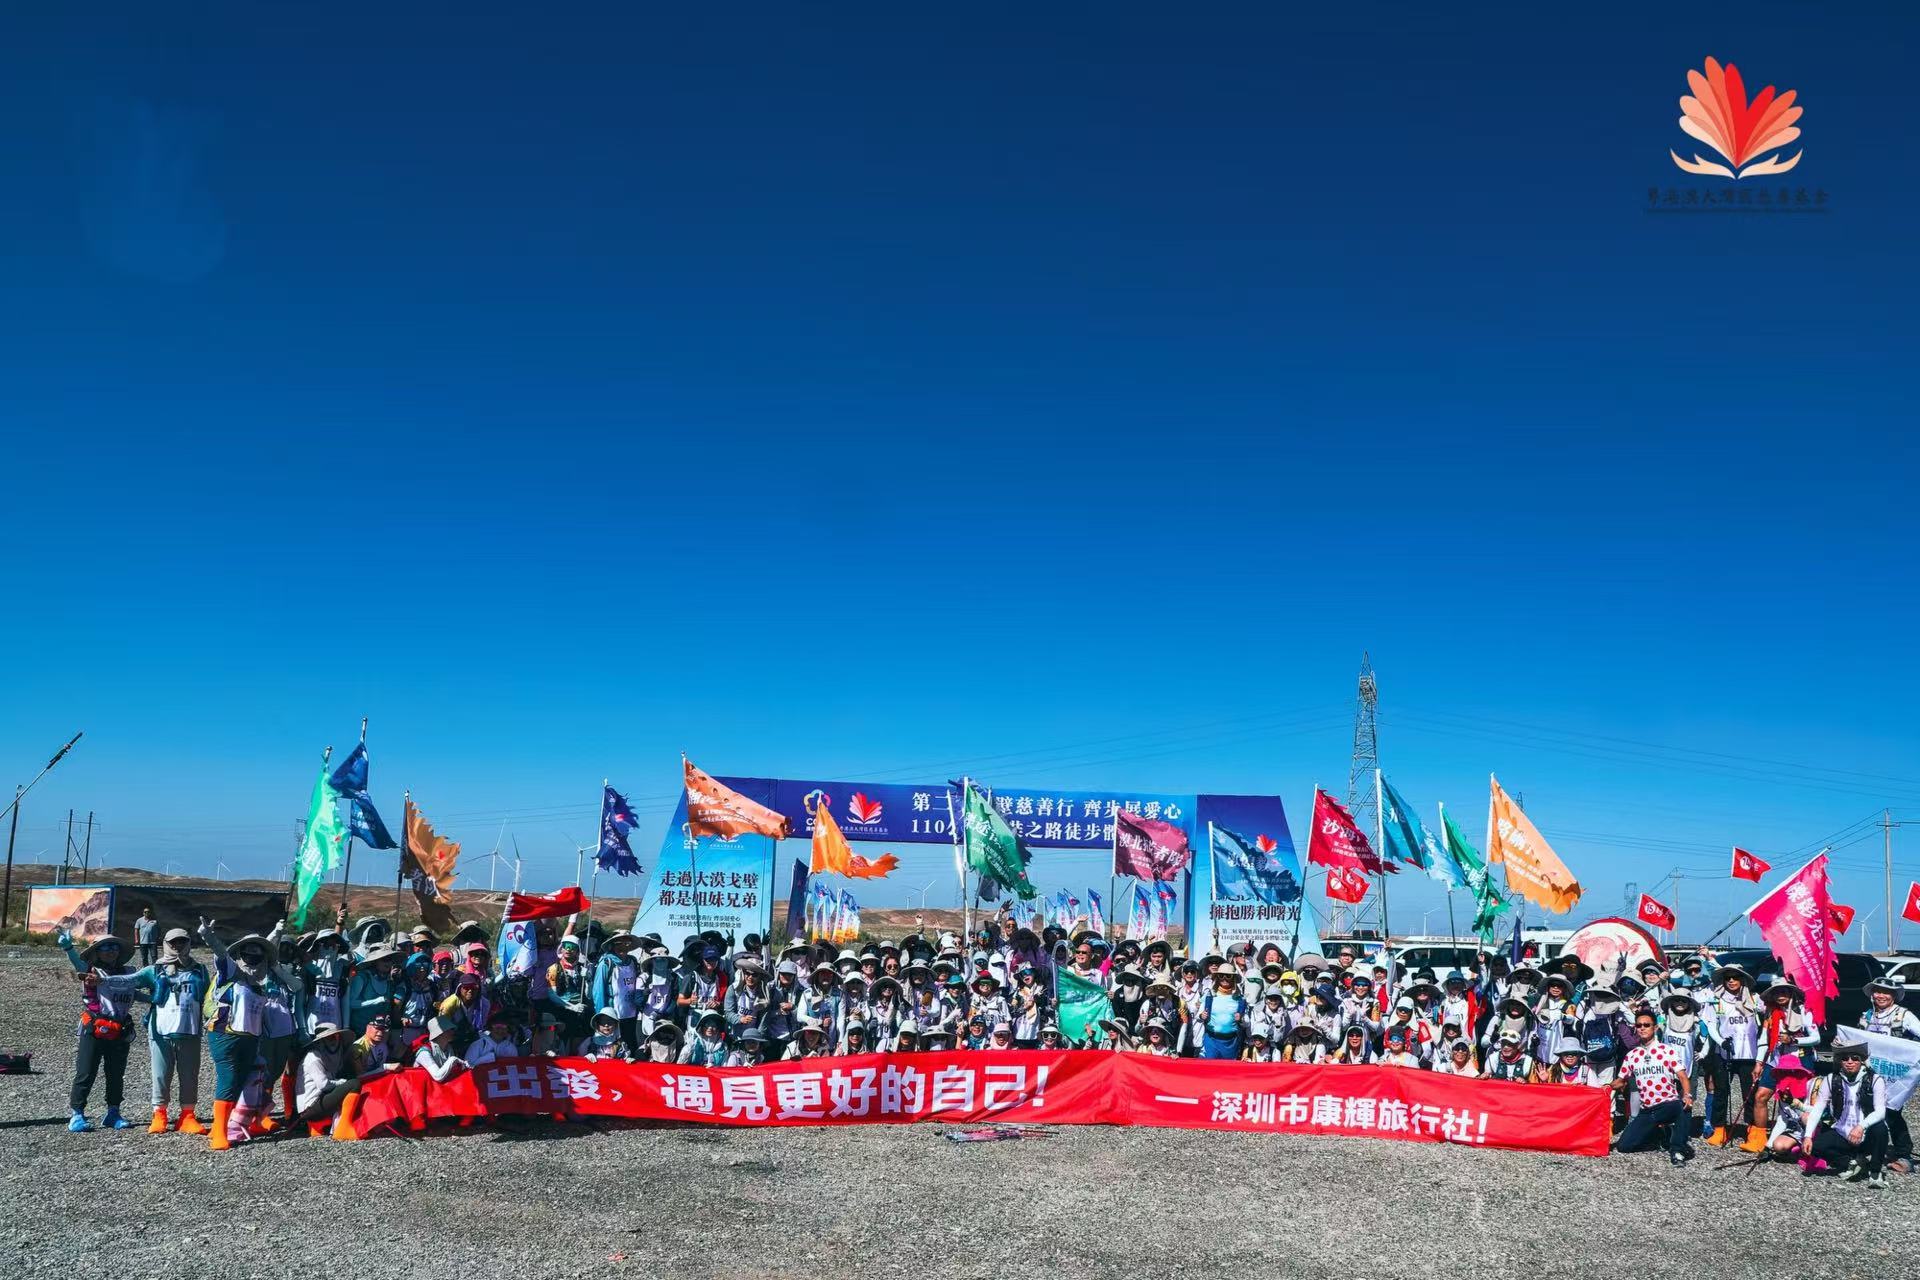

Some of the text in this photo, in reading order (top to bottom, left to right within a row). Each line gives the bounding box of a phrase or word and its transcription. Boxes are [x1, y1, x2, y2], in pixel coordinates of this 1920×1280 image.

[912, 792, 1074, 817] 第二壁慈善行
[660, 870, 759, 889] 走過大漠戈壁
[659, 890, 757, 909] 都是姐妹兄弟
[1210, 904, 1302, 921] 擁抱勝利曙光
[1729, 1016, 1749, 1025] 0604
[1668, 1035, 1687, 1047] 0602
[1633, 1065, 1664, 1077] BIANCHI
